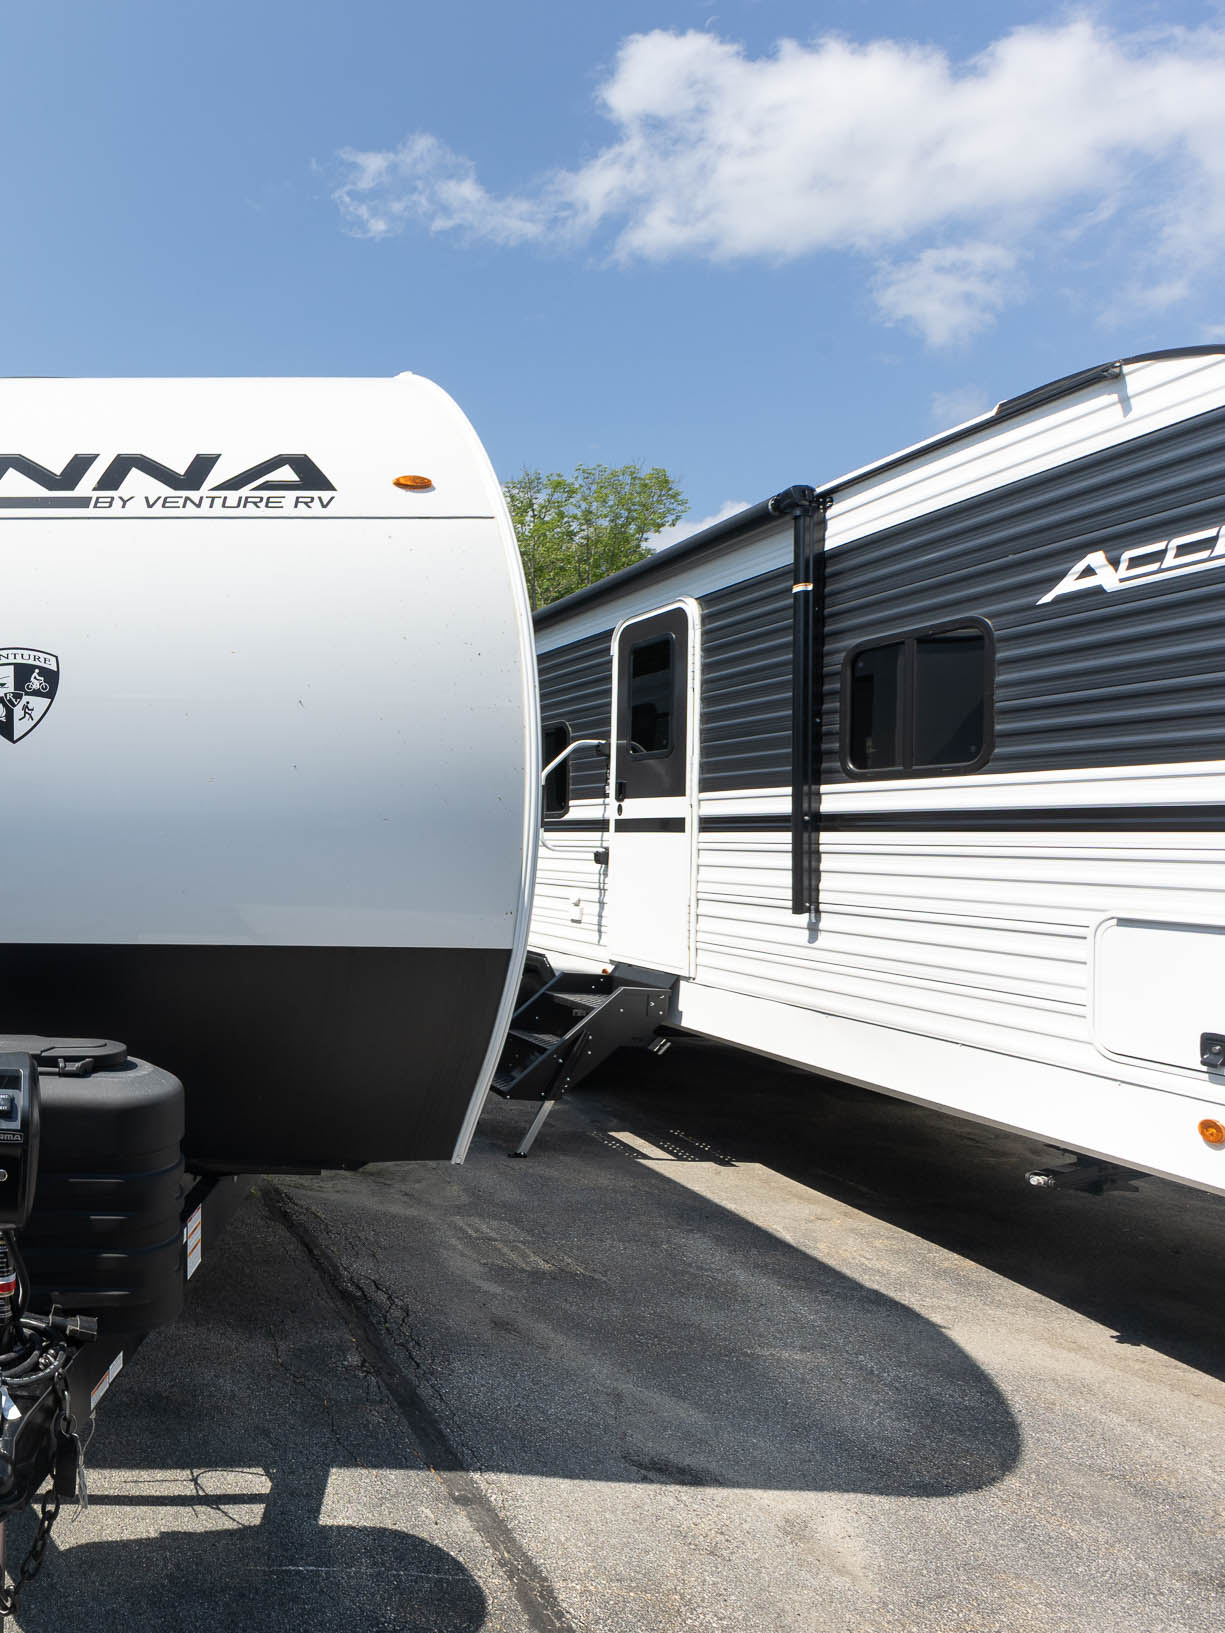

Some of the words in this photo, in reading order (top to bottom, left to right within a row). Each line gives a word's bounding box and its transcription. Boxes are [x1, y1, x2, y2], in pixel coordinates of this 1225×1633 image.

[92, 496, 135, 509] BY
[144, 496, 286, 509] VENTURE
[293, 496, 336, 509] RV
[1035, 525, 1225, 606] ACC
